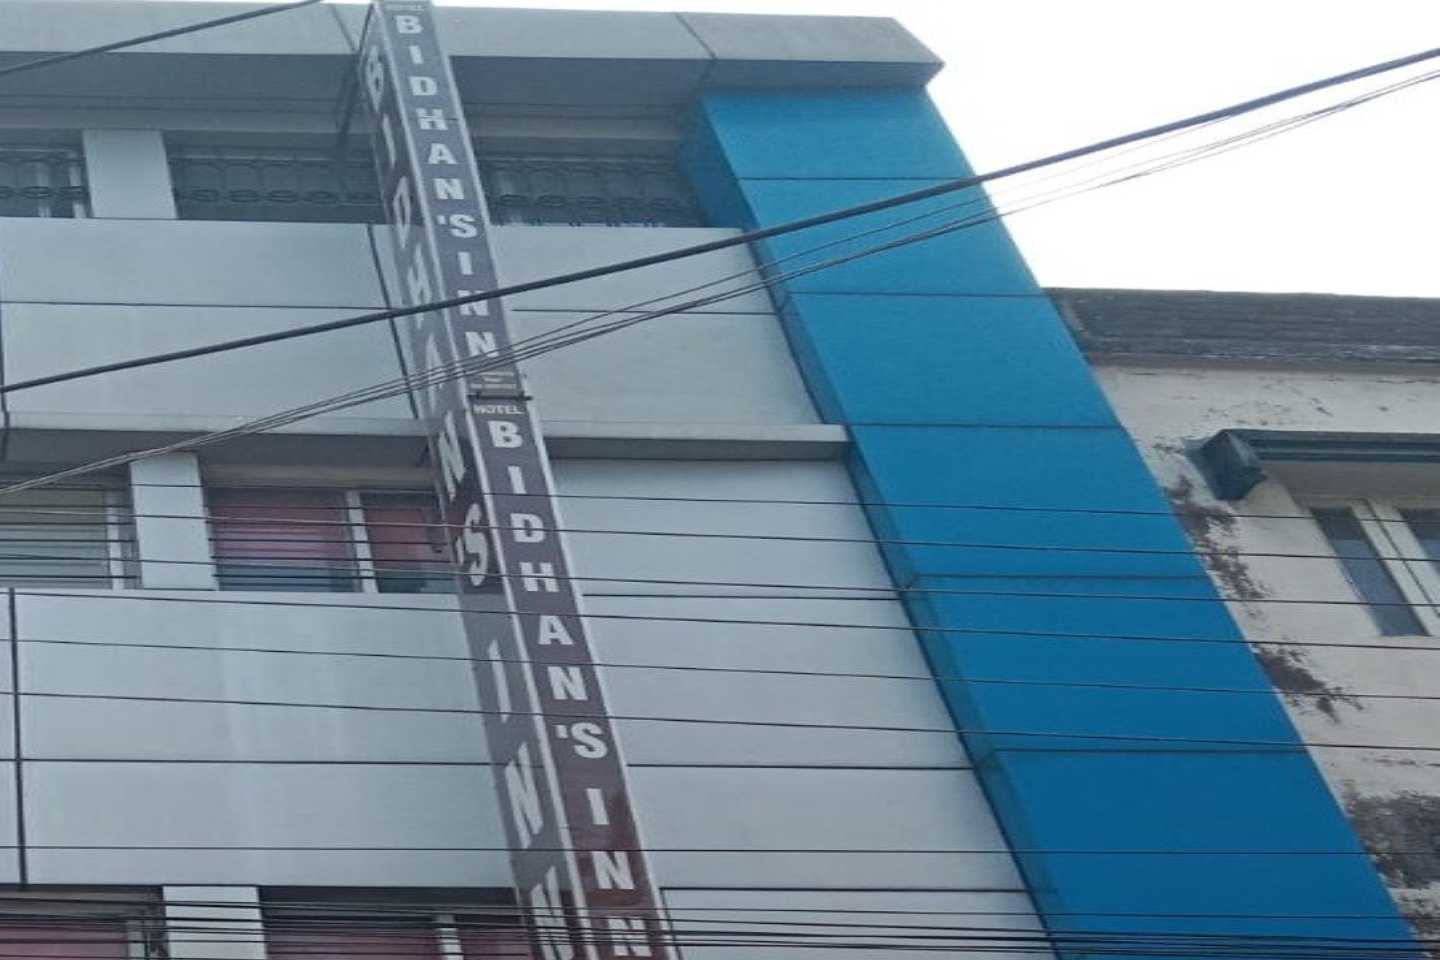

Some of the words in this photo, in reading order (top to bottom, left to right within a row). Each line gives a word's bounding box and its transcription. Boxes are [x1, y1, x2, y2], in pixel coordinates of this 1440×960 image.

[396, 15, 478, 238] BIDHAN'S
[487, 420, 608, 759] BIDHAN'S
[586, 787, 652, 957] INN
